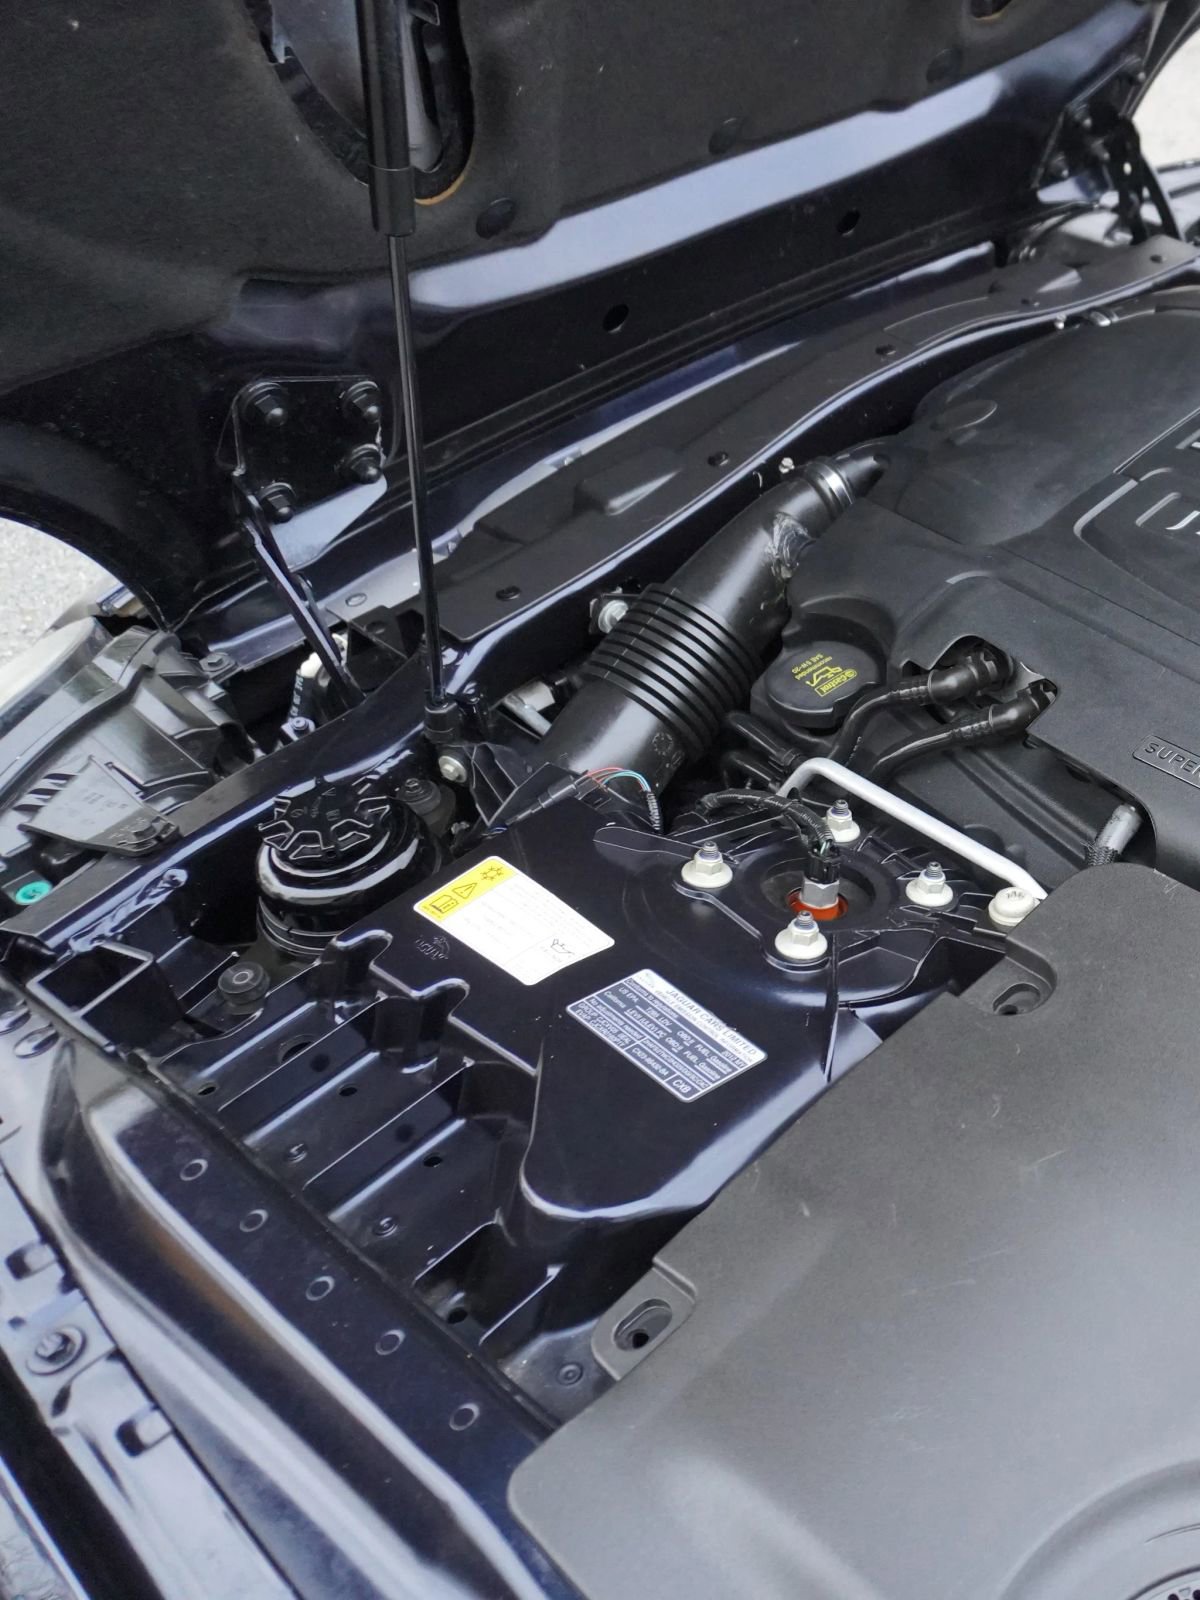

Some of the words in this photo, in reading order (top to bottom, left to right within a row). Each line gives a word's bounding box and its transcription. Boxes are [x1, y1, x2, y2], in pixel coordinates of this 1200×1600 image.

[820, 674, 848, 693] Castrol
[664, 988, 702, 1015] JAGUAR
[697, 1012, 726, 1032] CARS
[721, 1029, 759, 1056] LIMITED
[708, 1054, 734, 1073] Gasoline
[669, 1077, 693, 1094] CXB
